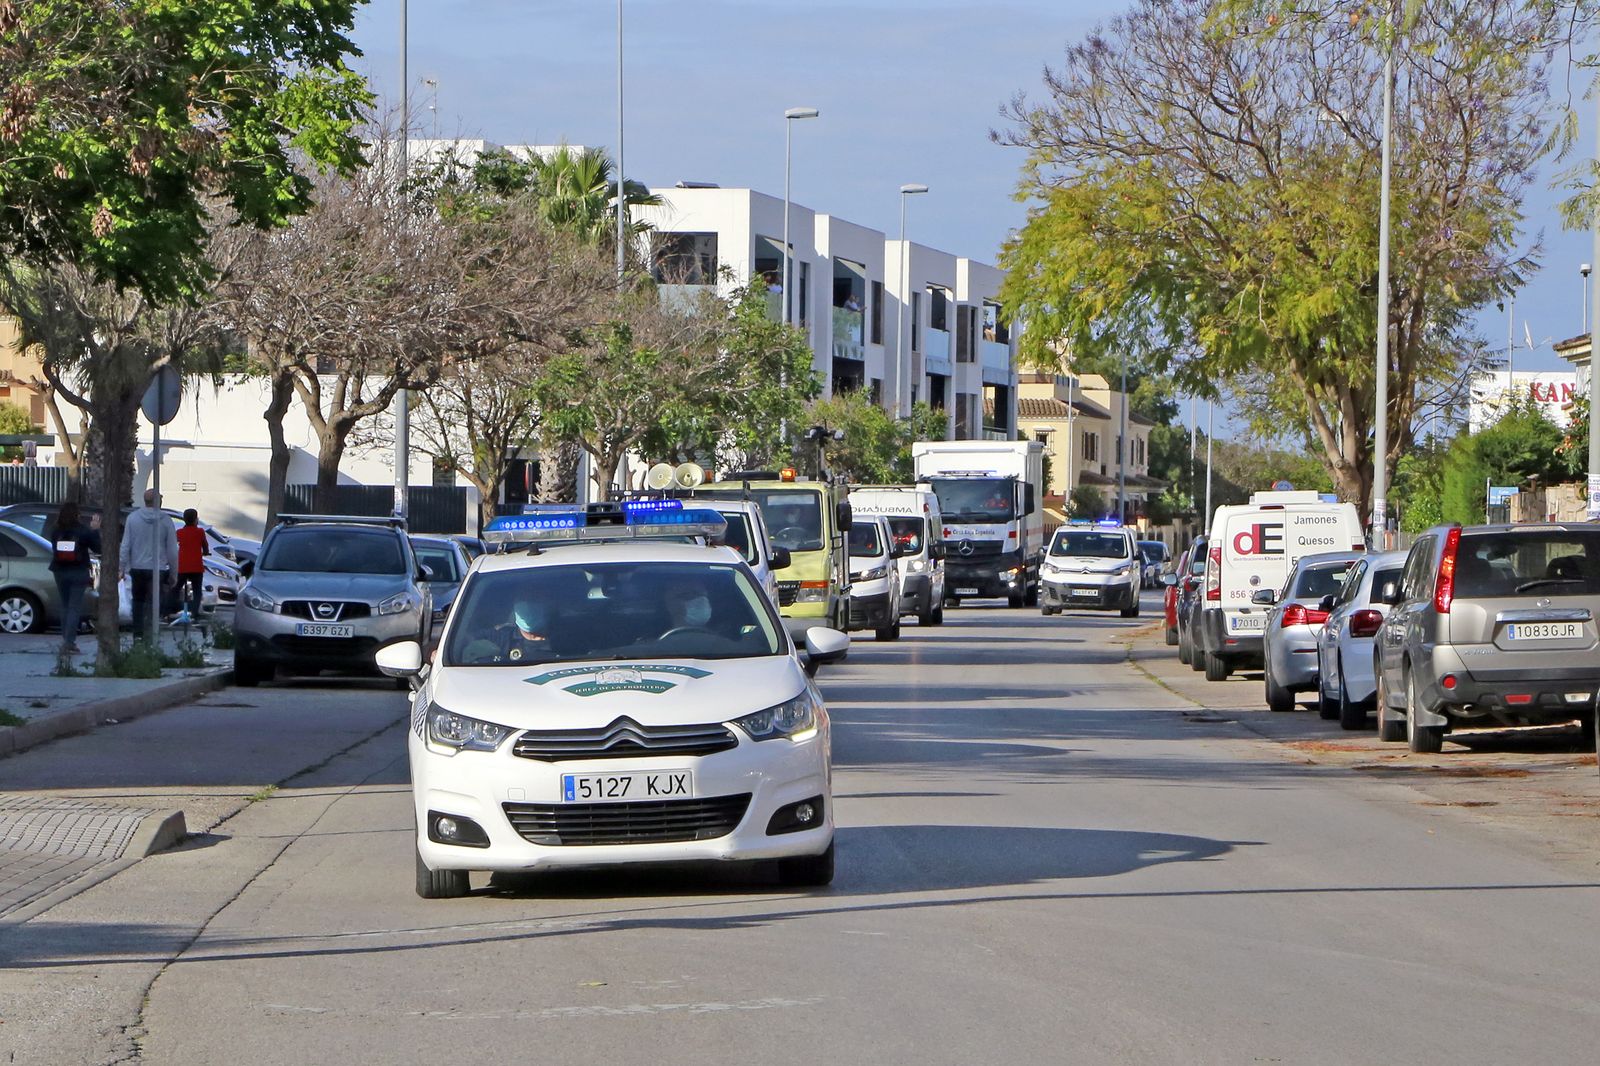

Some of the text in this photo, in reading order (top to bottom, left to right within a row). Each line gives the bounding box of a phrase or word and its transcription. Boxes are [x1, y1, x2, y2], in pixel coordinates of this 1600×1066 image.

[1294, 516, 1338, 525] Jamones
[1233, 523, 1285, 555] dE
[1298, 536, 1335, 545] Quesos
[1230, 590, 1246, 598] 856
[1238, 619, 1258, 627] 7010
[303, 625, 349, 636] 6397 GZX
[631, 664, 688, 672] LOCAL
[579, 777, 632, 798] 5127
[647, 774, 687, 795] KJX
